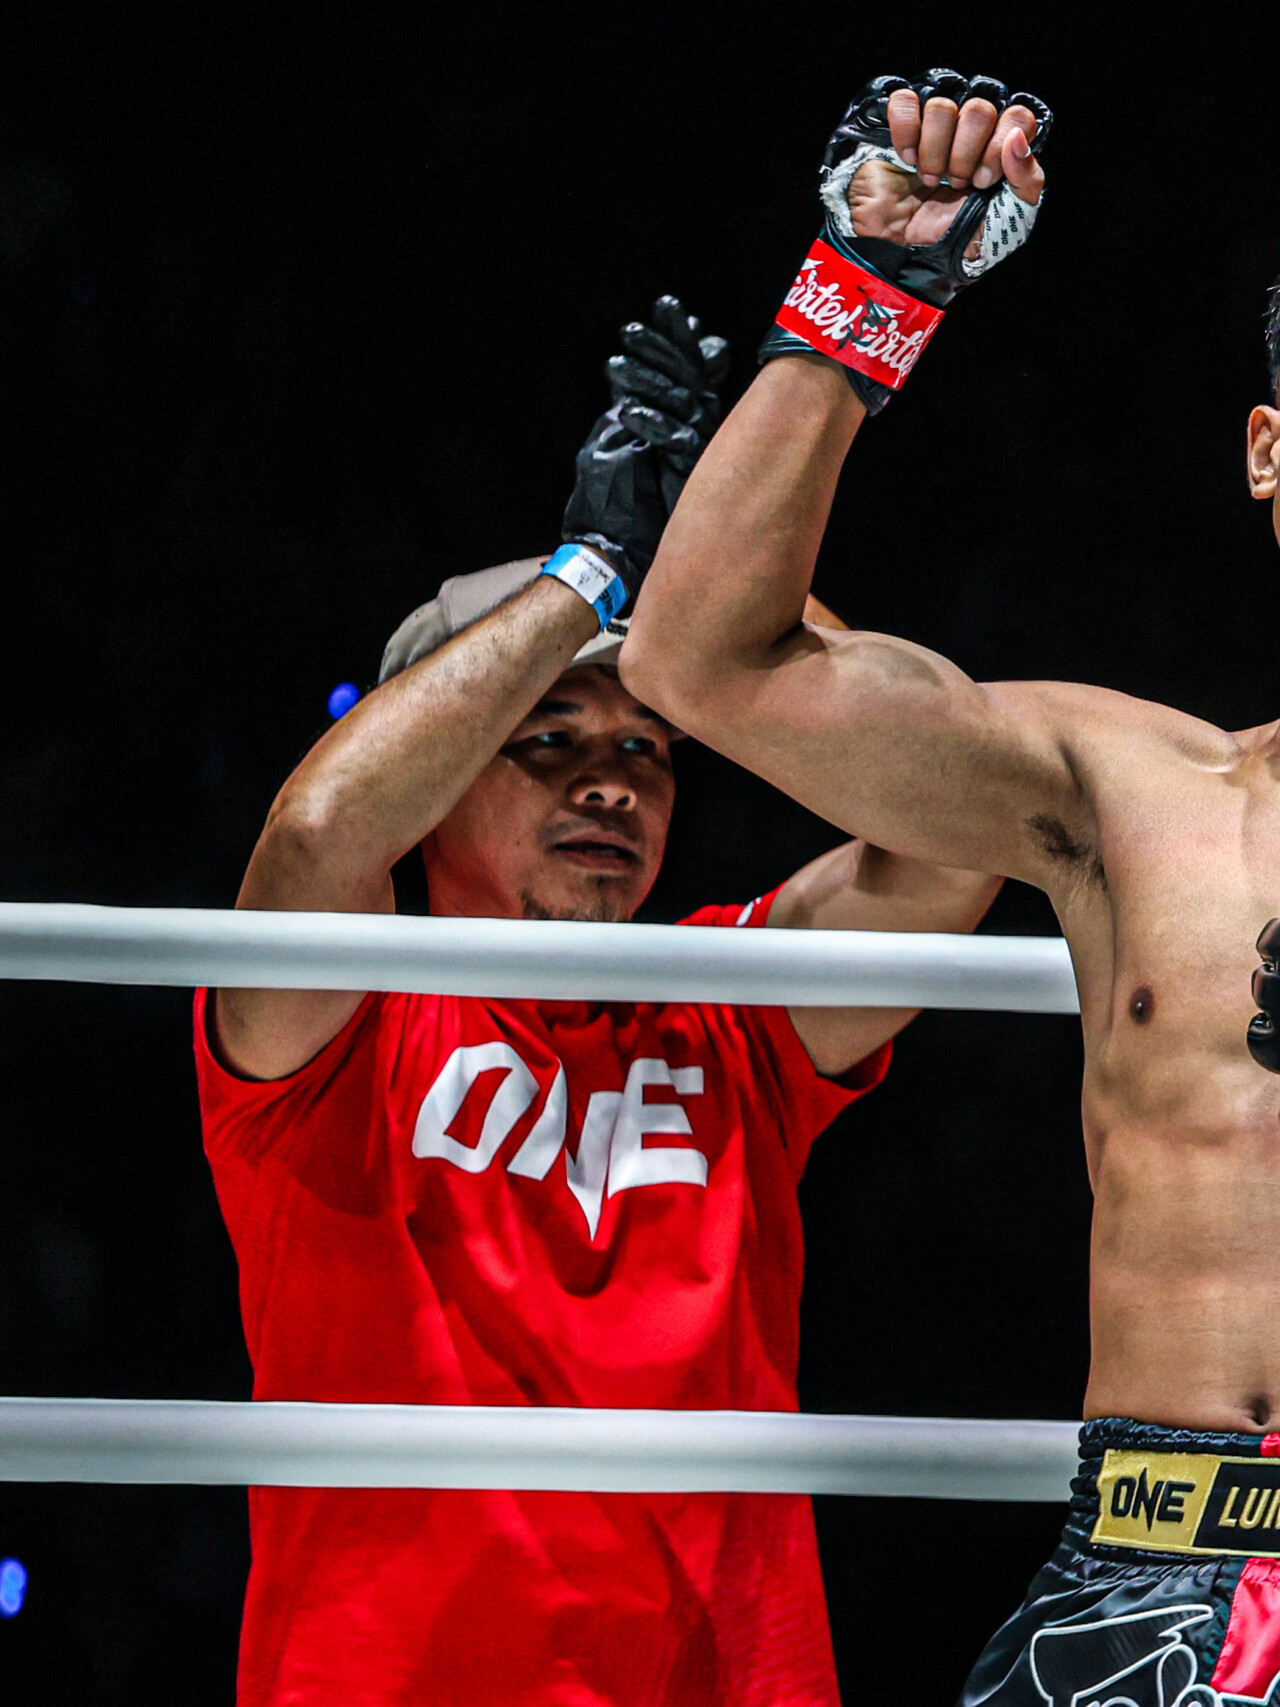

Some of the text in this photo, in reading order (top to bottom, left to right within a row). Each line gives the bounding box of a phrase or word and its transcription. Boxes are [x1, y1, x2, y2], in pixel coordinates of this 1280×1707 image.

[1001, 229, 1009, 245] ONE
[1009, 215, 1019, 233] ONE
[412, 1041, 708, 1242] ONE
[1111, 1467, 1196, 1532] ONE
